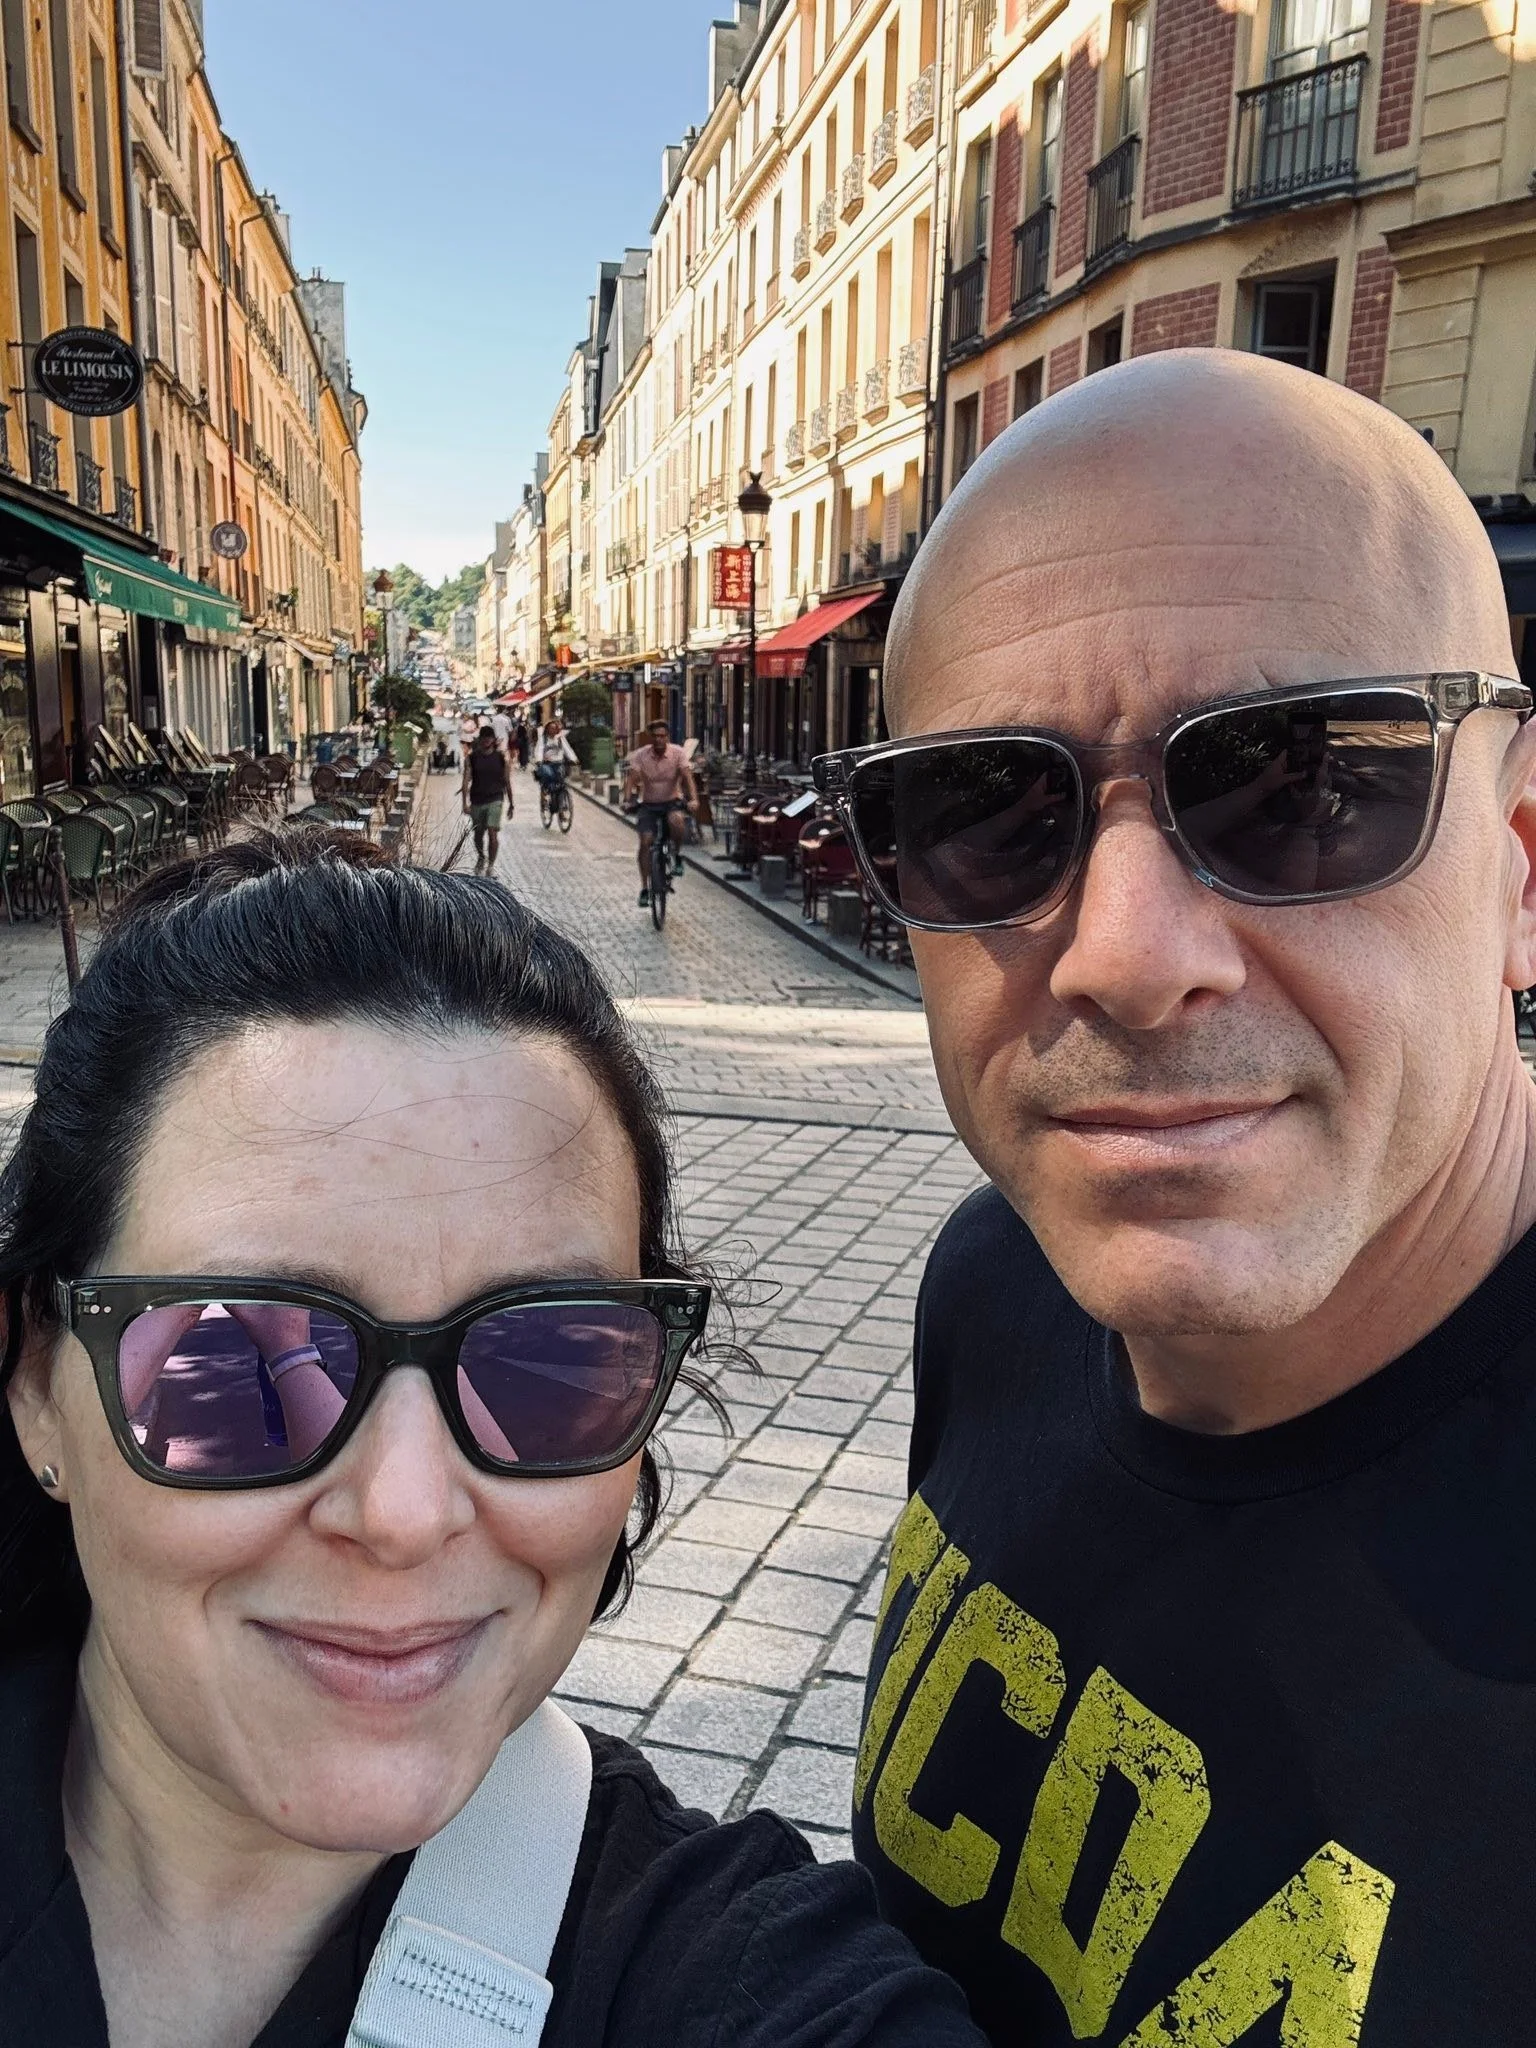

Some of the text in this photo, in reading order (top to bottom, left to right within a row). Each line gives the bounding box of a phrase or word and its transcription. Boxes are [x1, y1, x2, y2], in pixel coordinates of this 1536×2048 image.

[56, 346, 116, 360] Restaurant
[41, 360, 135, 380] LE LIMOUSIN
